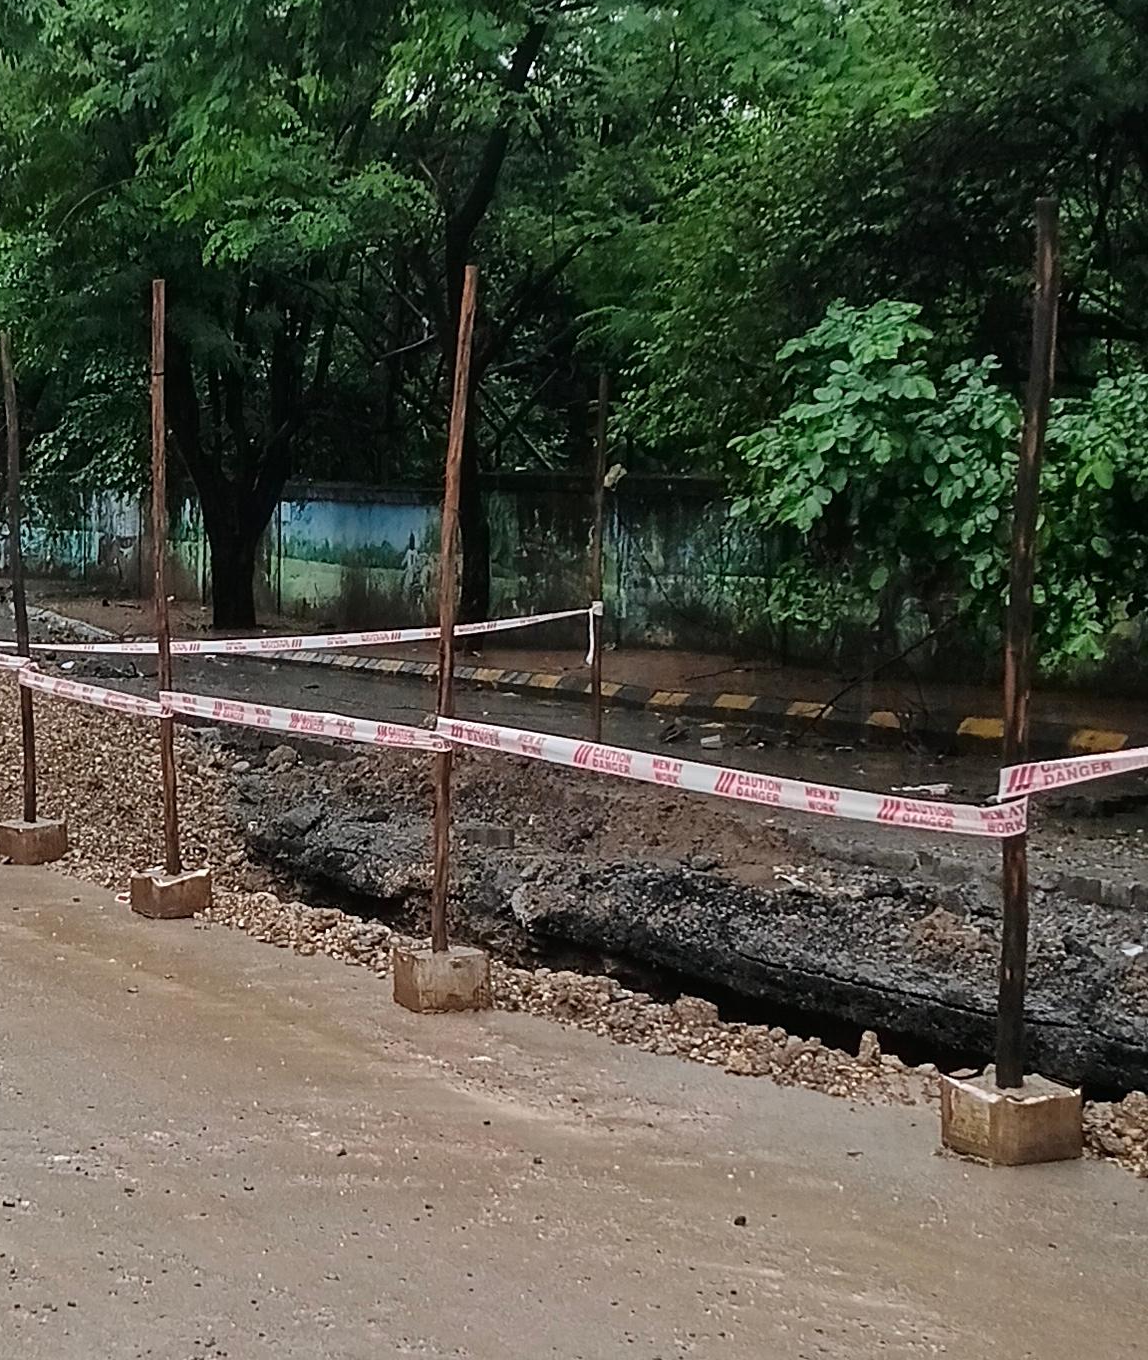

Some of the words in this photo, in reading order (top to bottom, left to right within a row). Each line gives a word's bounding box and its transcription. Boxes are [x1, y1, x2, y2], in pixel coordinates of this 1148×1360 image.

[466, 732, 501, 747] DANGER
[593, 747, 633, 765] CAUTION
[592, 759, 632, 775] DANGER
[652, 757, 671, 772] MEN
[672, 762, 683, 774] AT
[1044, 761, 1113, 786] DANGER
[654, 771, 679, 785] WORK
[737, 774, 782, 792] CAUTION
[736, 785, 781, 804] DANGER
[805, 786, 826, 800] MEN
[827, 790, 840, 802] AT
[807, 800, 836, 814] WORK
[903, 801, 956, 818] CAUTION
[1005, 802, 1026, 818] AT
[902, 812, 955, 829] DANGER
[987, 818, 1026, 834] WORK
